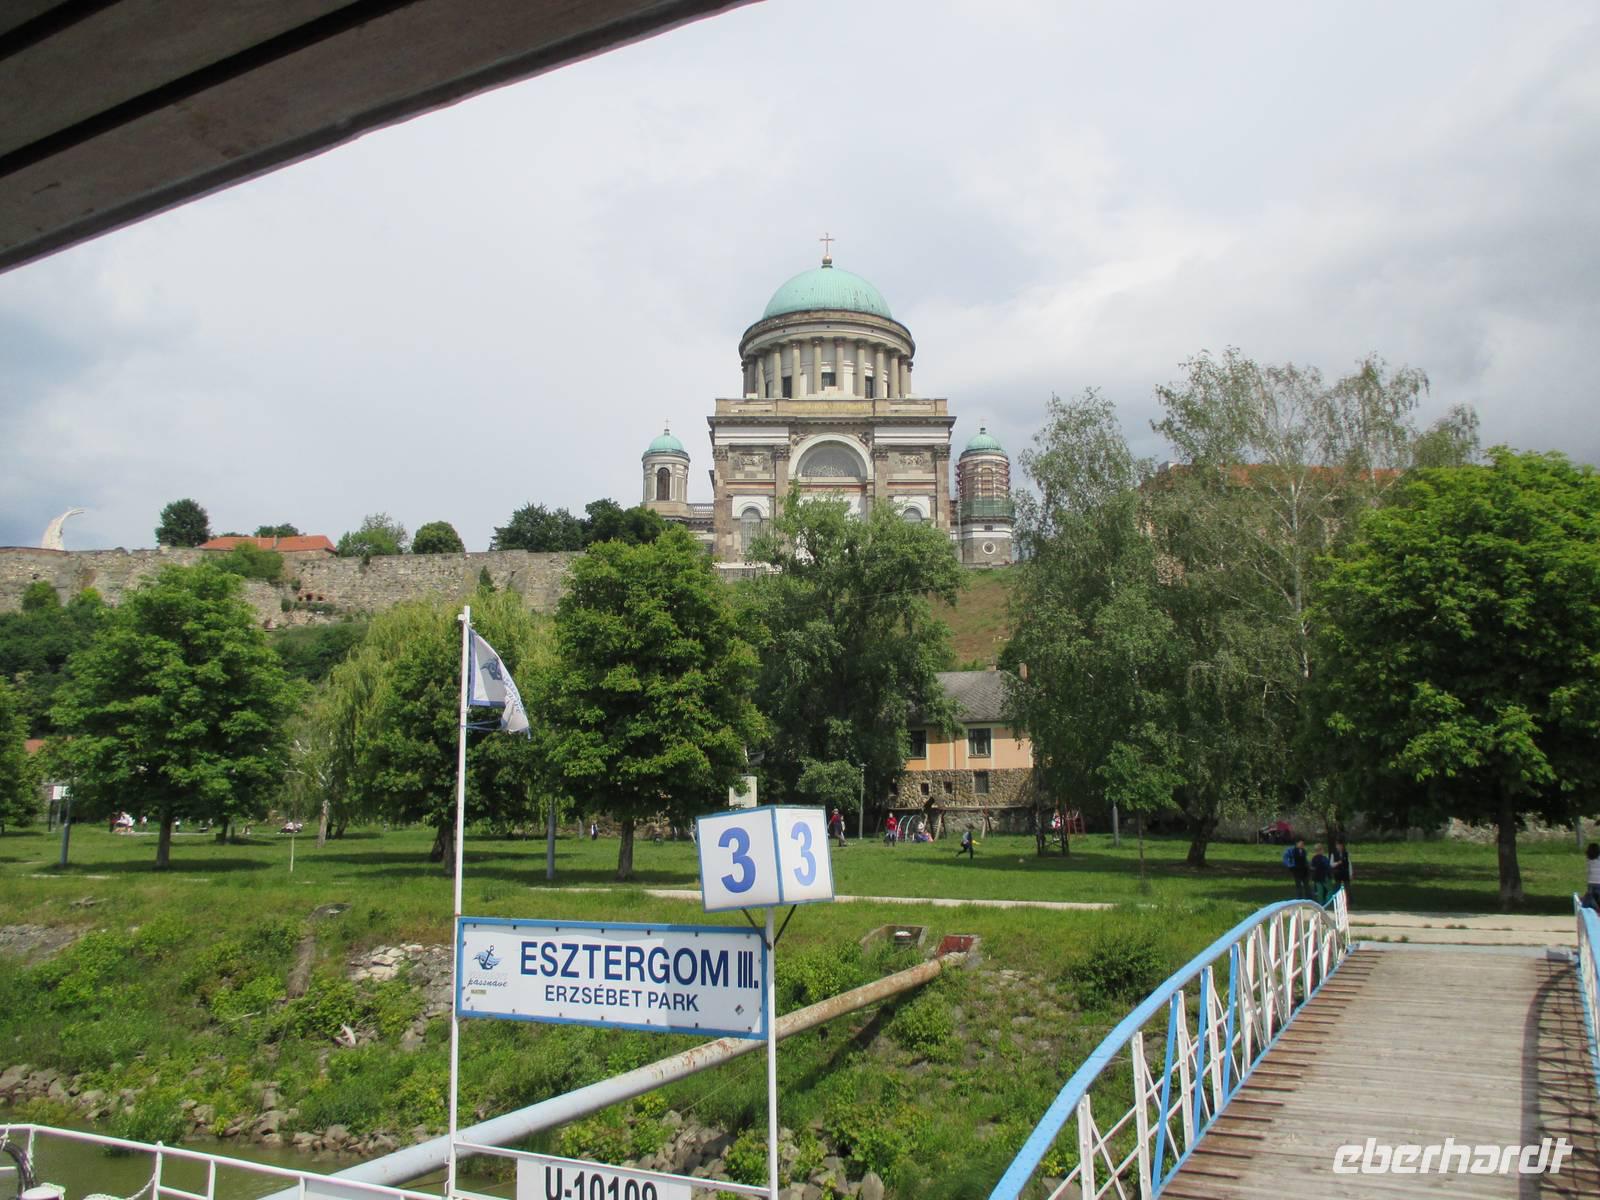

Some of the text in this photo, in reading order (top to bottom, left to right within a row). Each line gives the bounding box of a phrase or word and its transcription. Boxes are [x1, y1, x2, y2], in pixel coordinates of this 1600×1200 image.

[717, 827, 757, 894] 3
[790, 821, 817, 887] 3
[520, 941, 730, 989] ESZTERGOM
[545, 984, 700, 1013] ERZSÉBET PARK
